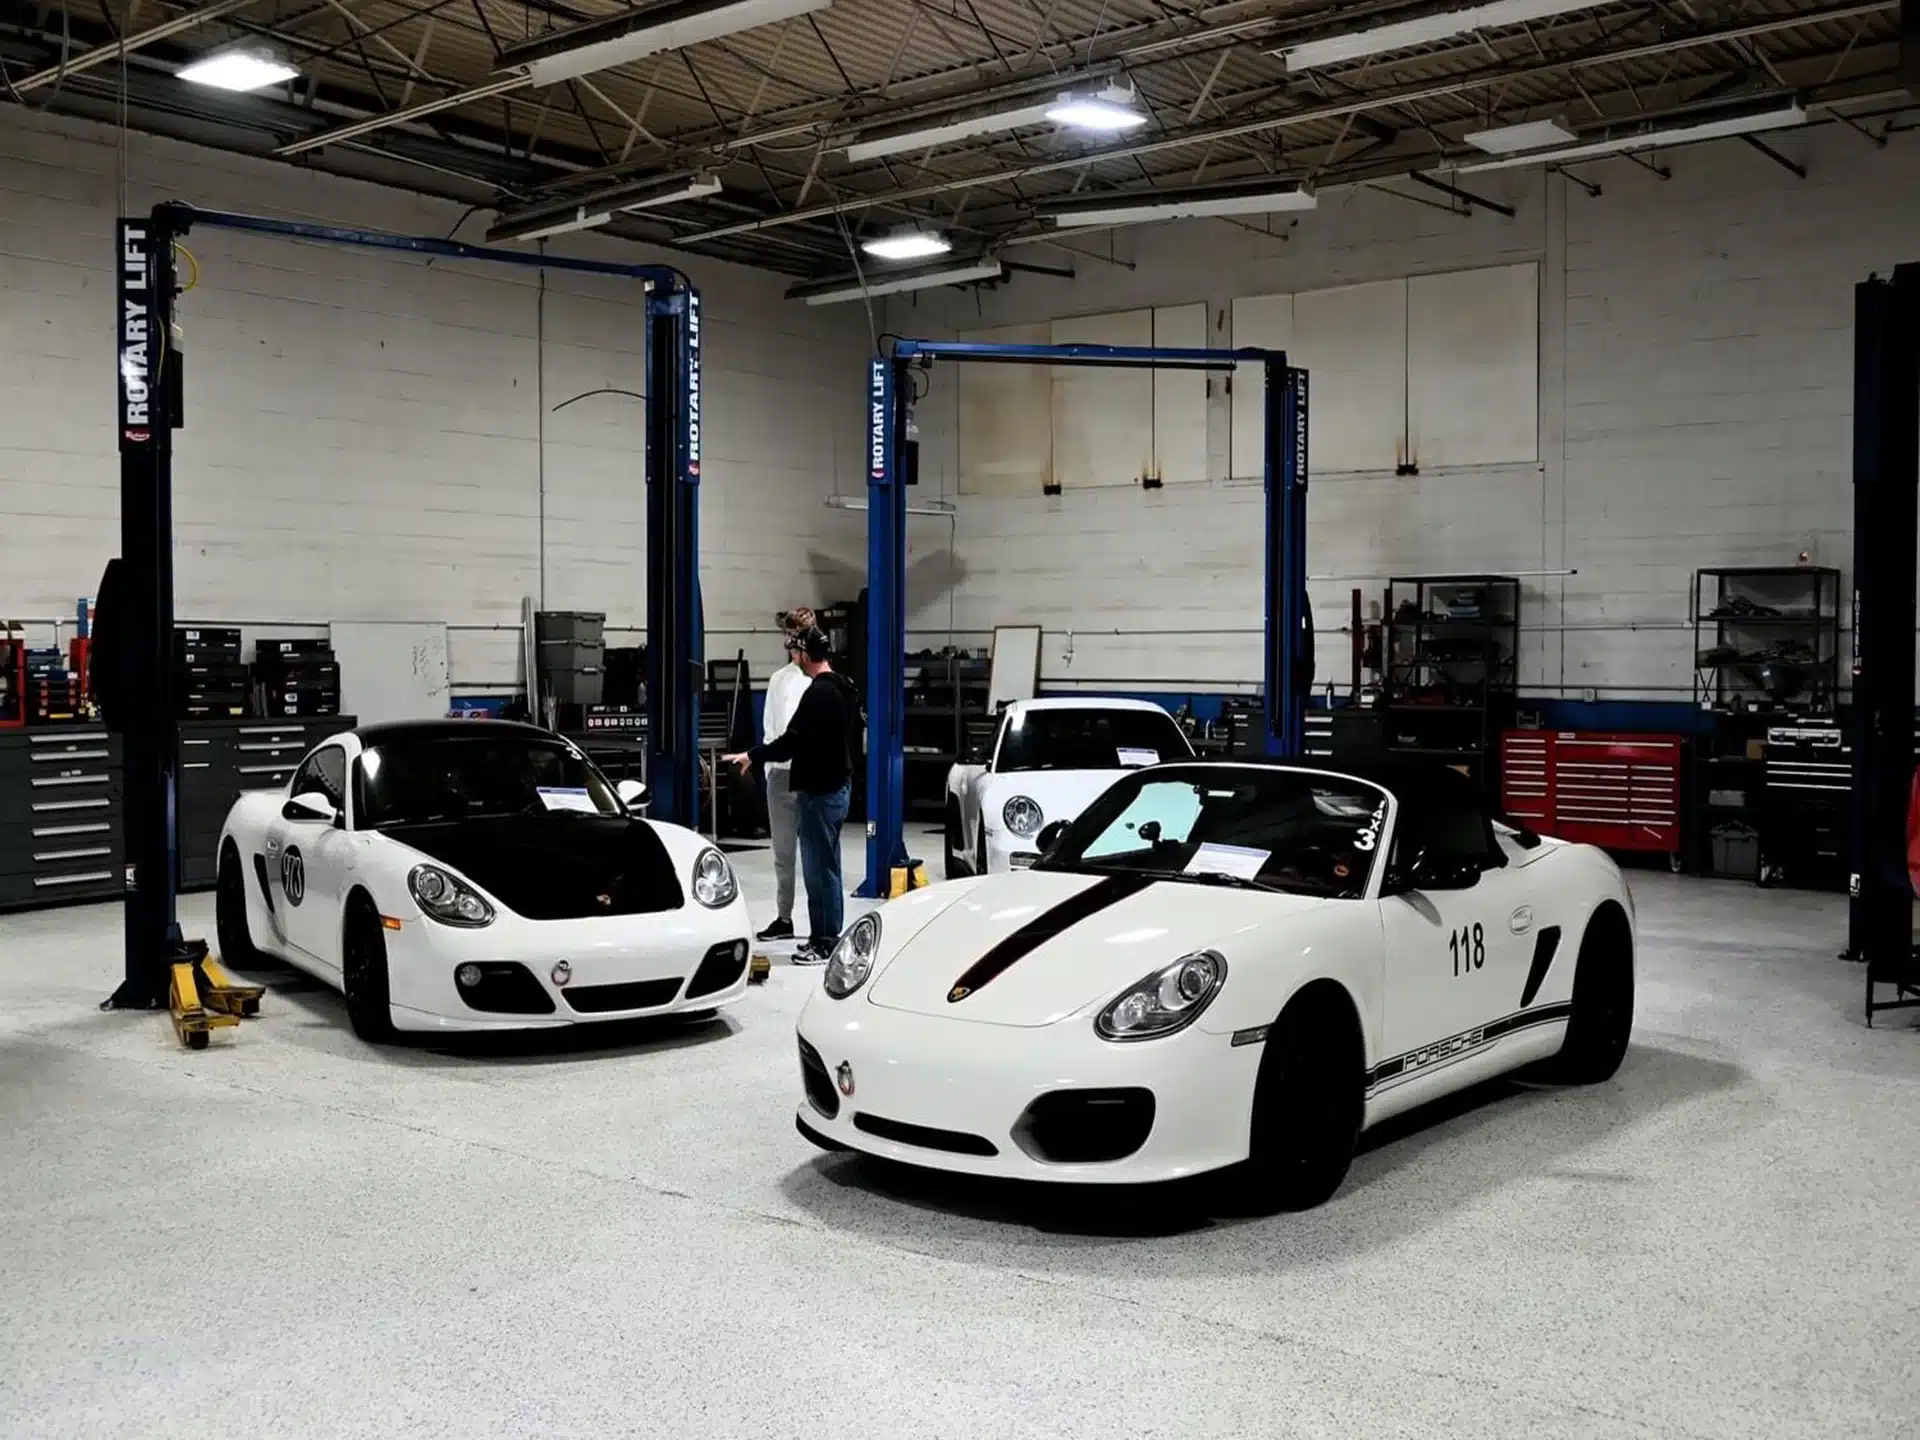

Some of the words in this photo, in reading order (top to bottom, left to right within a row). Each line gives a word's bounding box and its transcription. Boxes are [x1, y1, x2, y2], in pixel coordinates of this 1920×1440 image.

[124, 225, 147, 289] LIFT
[689, 290, 699, 348] LIFT
[125, 299, 149, 425] ROTARY
[873, 361, 885, 397] LIFT
[1297, 372, 1307, 406] LIFT
[872, 402, 885, 469] ROTARY
[1296, 411, 1306, 476] ROTARY
[1449, 922, 1485, 977] 118
[1403, 1027, 1484, 1071] PORSCHE
